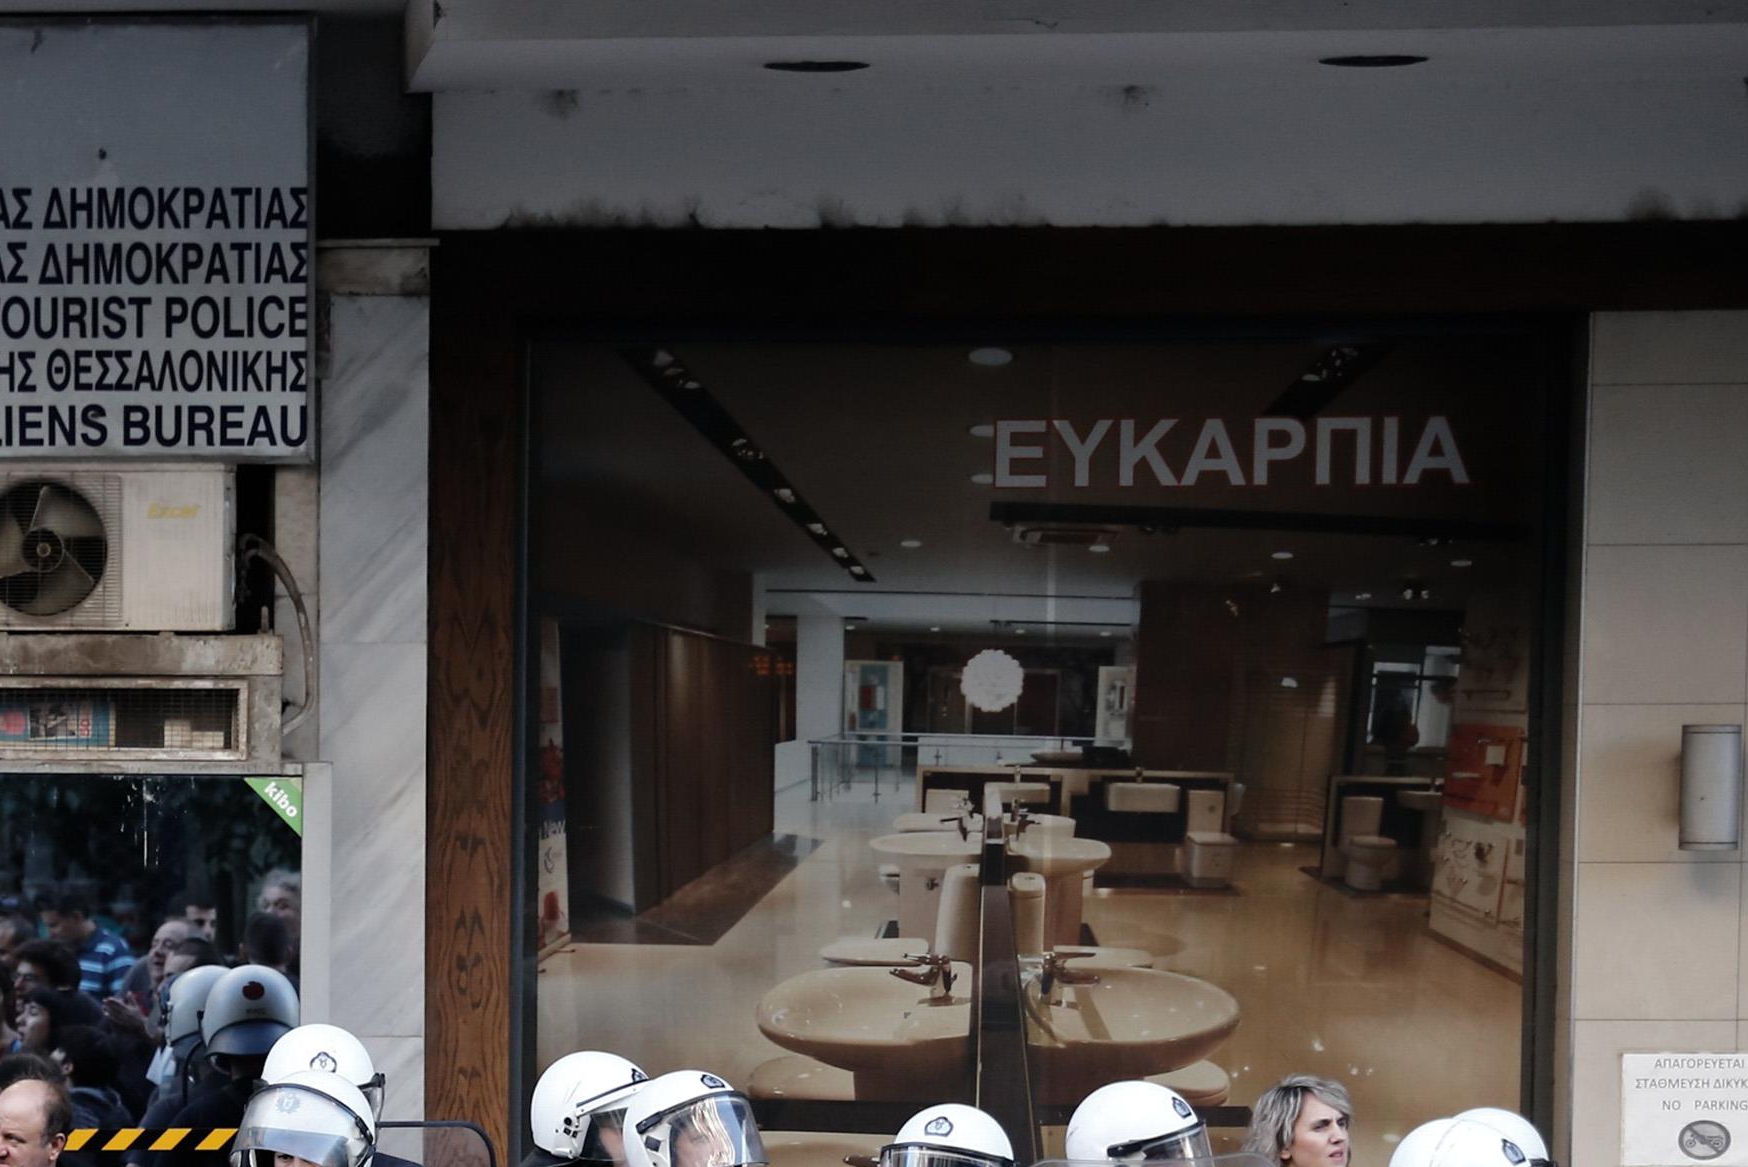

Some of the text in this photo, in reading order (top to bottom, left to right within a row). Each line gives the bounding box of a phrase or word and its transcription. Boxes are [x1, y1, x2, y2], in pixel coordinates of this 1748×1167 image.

[43, 186, 308, 230] ΔΗΜΟΚΡΑΤΙΑΣ
[38, 241, 308, 285] ΔΗΜΟΚΡΑΤΙΑΣ
[165, 297, 308, 339] POLICE
[47, 349, 308, 392] ΘΕΣΣΑΛΟΝΙΚΗΣ
[123, 405, 308, 447] BUREAU
[994, 416, 1470, 487] ΕΥΚΑΡΠΙΑ
[264, 781, 298, 817] kibo
[1635, 1078, 1710, 1090] ΣΤΑΘΜΕΥΣΗ
[1654, 1058, 1745, 1070] ΑΠΑΓΟΡΕΥΕΤΑΙ
[1662, 1100, 1748, 1111] NO PARKING
